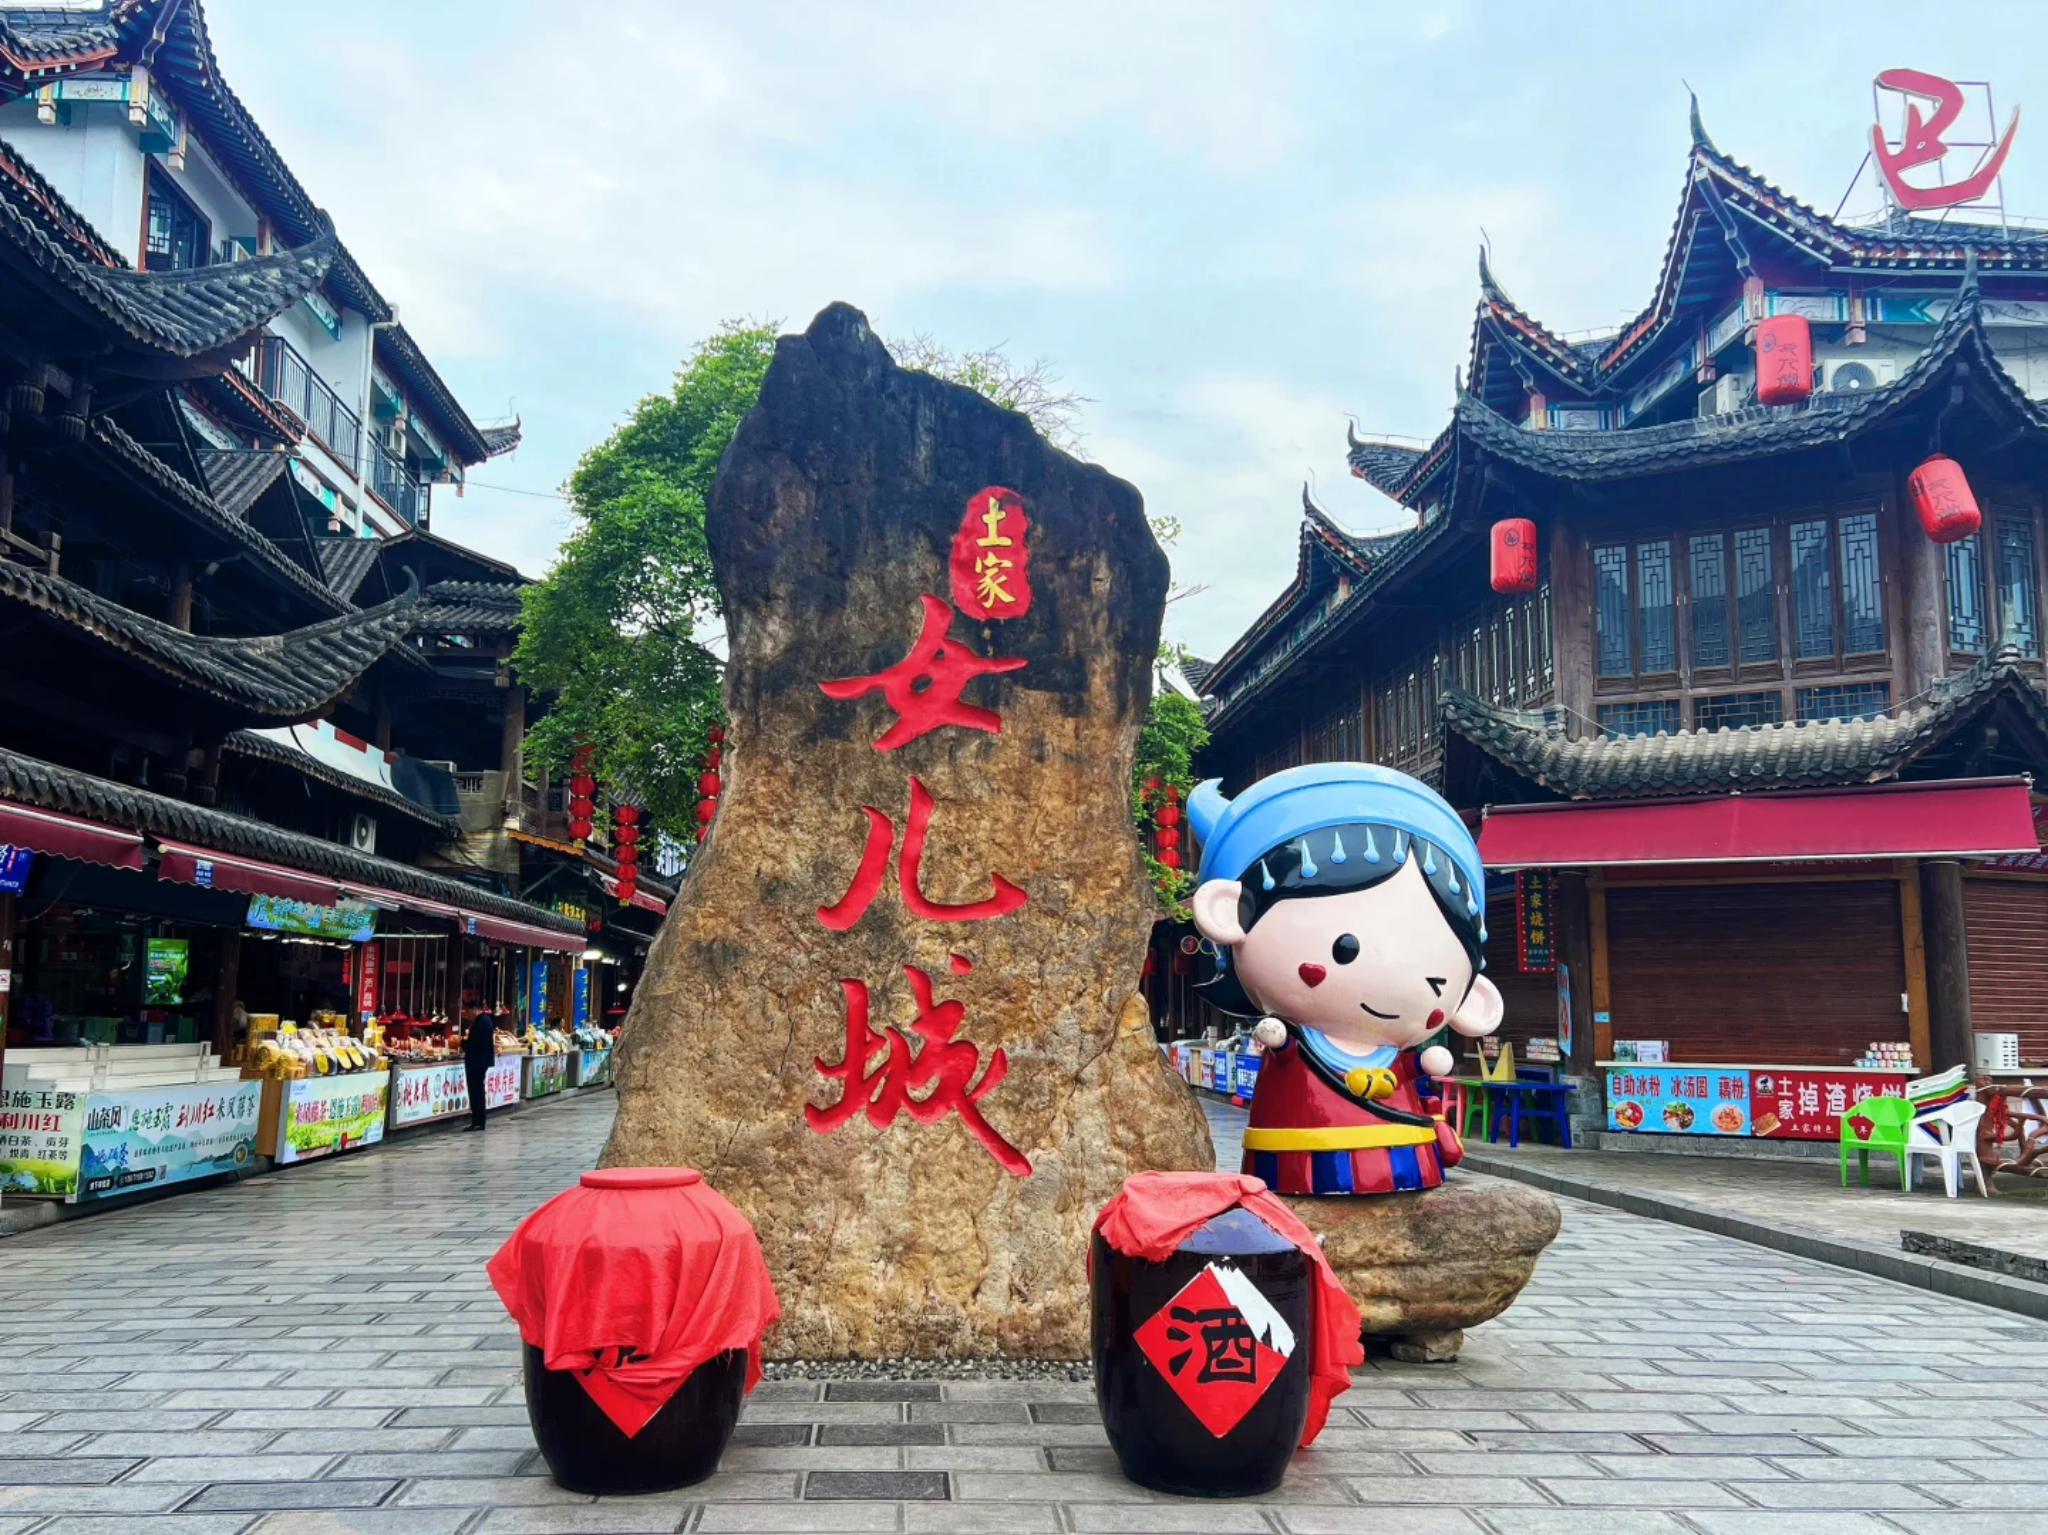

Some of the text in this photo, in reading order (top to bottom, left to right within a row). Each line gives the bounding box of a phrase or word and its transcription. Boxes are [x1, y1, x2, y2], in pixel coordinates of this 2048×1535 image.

[975, 496, 1016, 608] 土家
[804, 593, 1033, 1177] 女儿城
[1529, 875, 1546, 945] 土家烧饼
[176, 1097, 215, 1128] 利川红
[1612, 1074, 1744, 1099] 自助冰粉 冰汤圆 藕粉
[1778, 1076, 1795, 1120] 土家
[0, 1112, 62, 1132] 利川红
[1166, 1306, 1256, 1383] 酒
